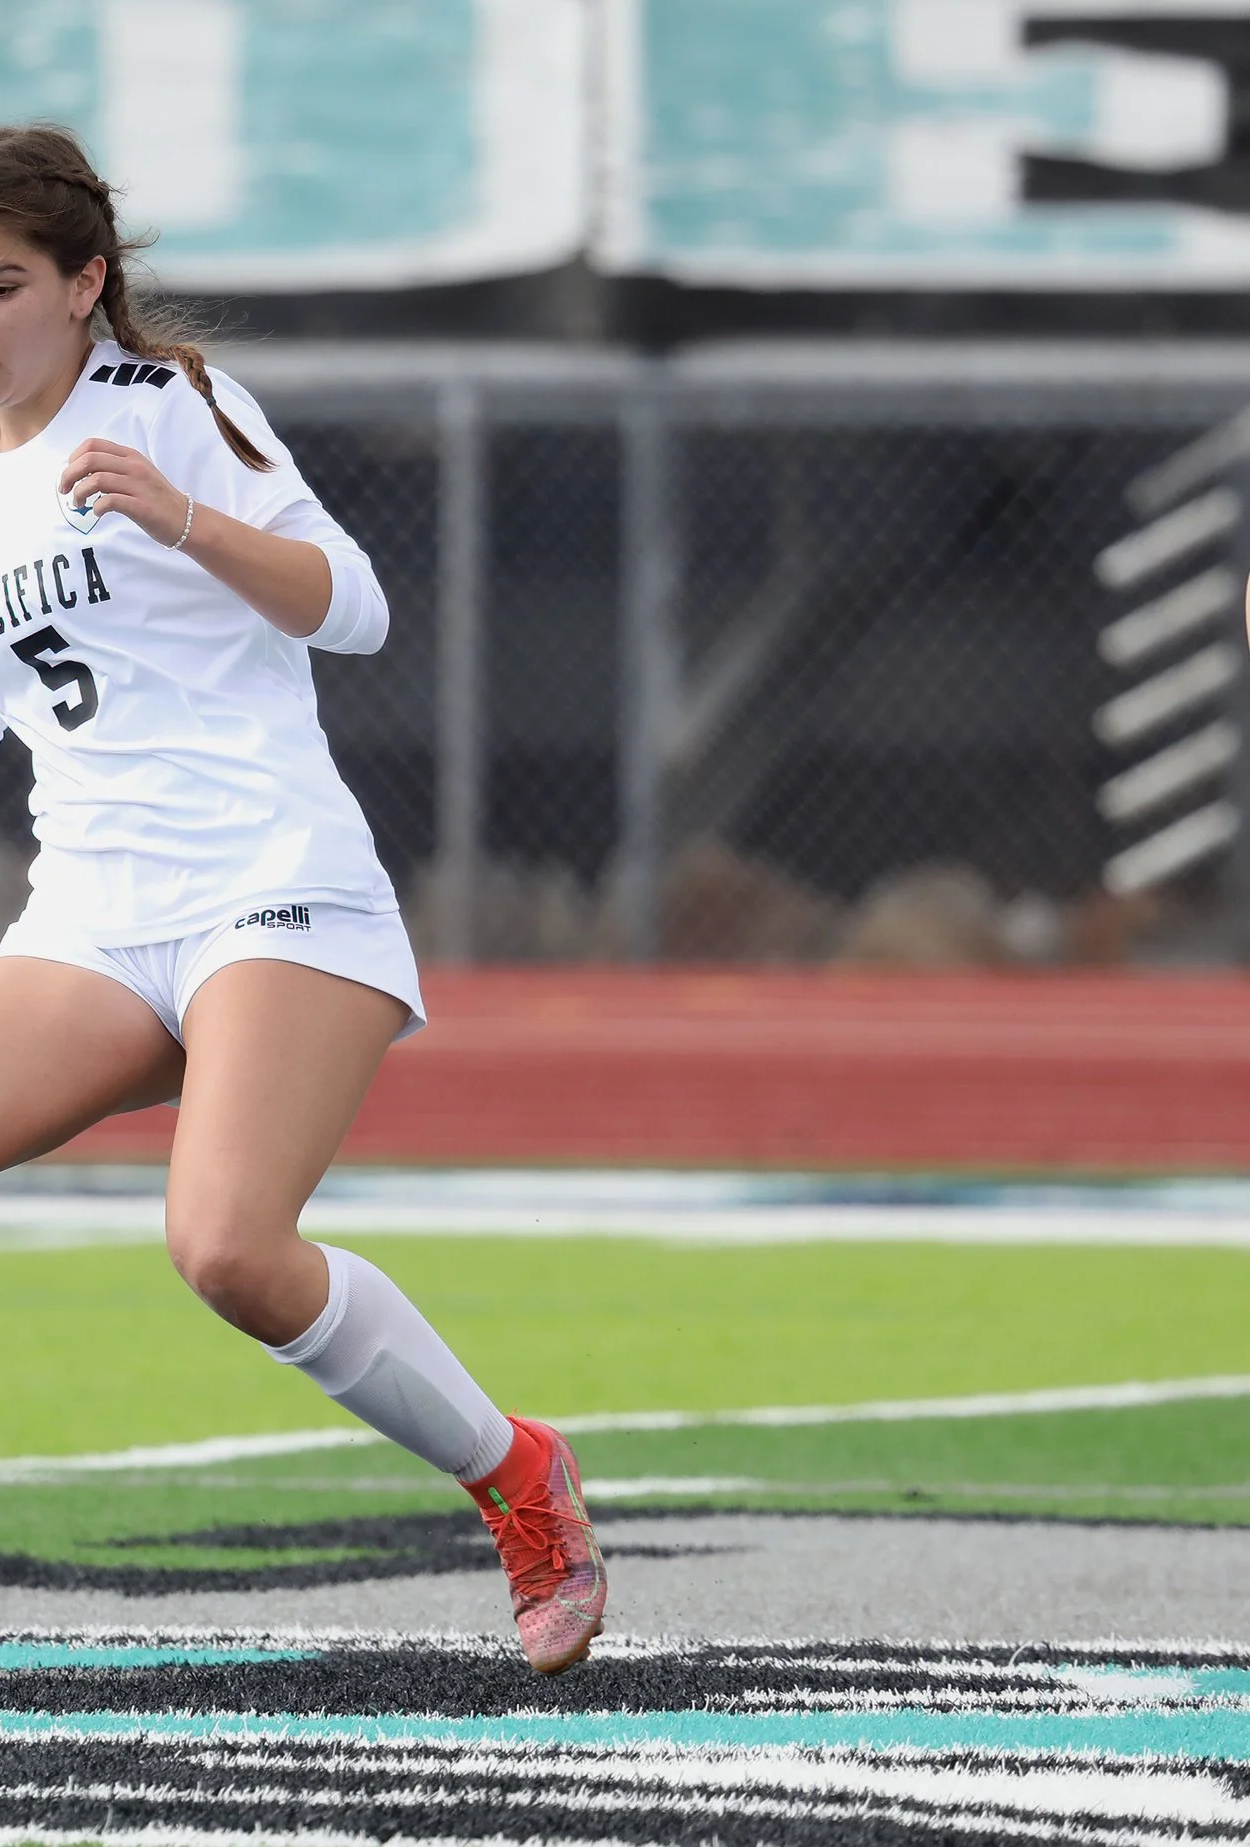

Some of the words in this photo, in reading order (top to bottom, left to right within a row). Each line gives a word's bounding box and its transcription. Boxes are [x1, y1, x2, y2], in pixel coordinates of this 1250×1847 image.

[10, 625, 99, 732] 5
[235, 905, 311, 930] capelli
[266, 921, 312, 933] SPORT
